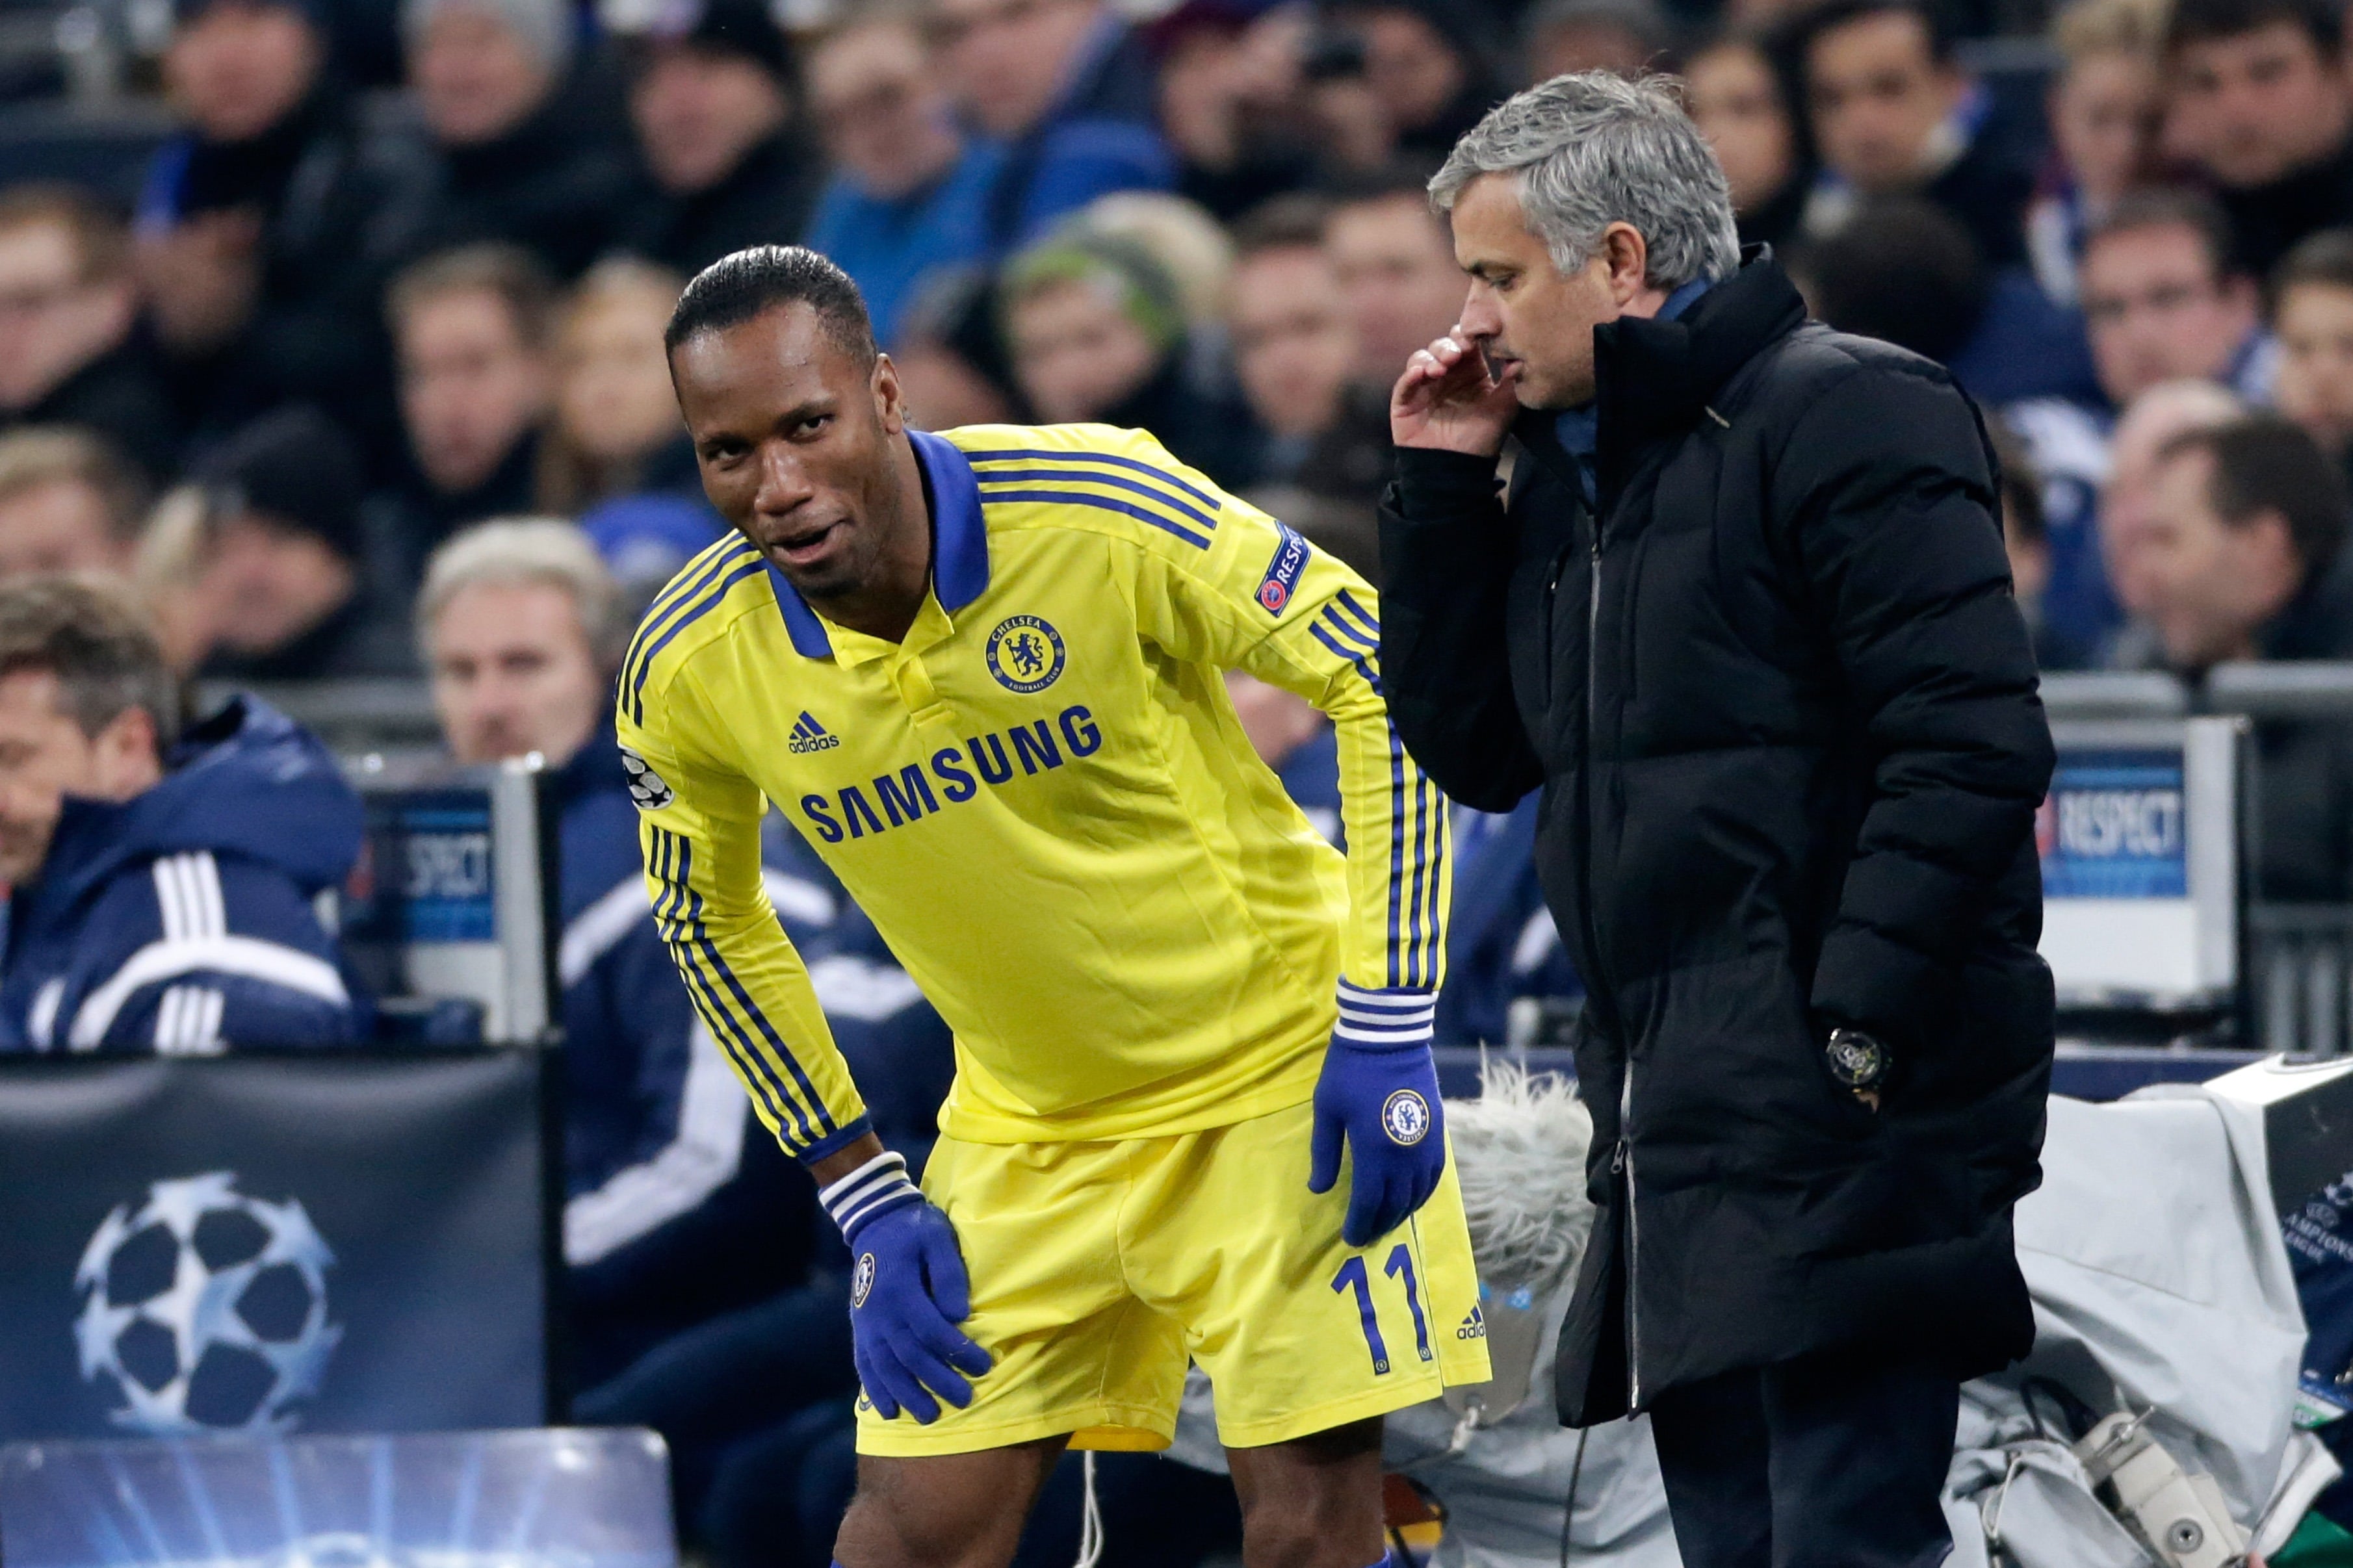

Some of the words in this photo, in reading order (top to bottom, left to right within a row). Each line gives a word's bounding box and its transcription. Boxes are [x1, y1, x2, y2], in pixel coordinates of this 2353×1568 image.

[1276, 526, 1303, 584] RESP
[992, 617, 1040, 641] CHELSEA
[788, 735, 840, 754] adidas
[801, 705, 1102, 842] SAMSUNG
[2059, 791, 2179, 856] RESPECT
[2283, 1213, 2353, 1262] AMPIONS
[1331, 1243, 1433, 1376] 11
[1457, 1322, 1485, 1340] adid
